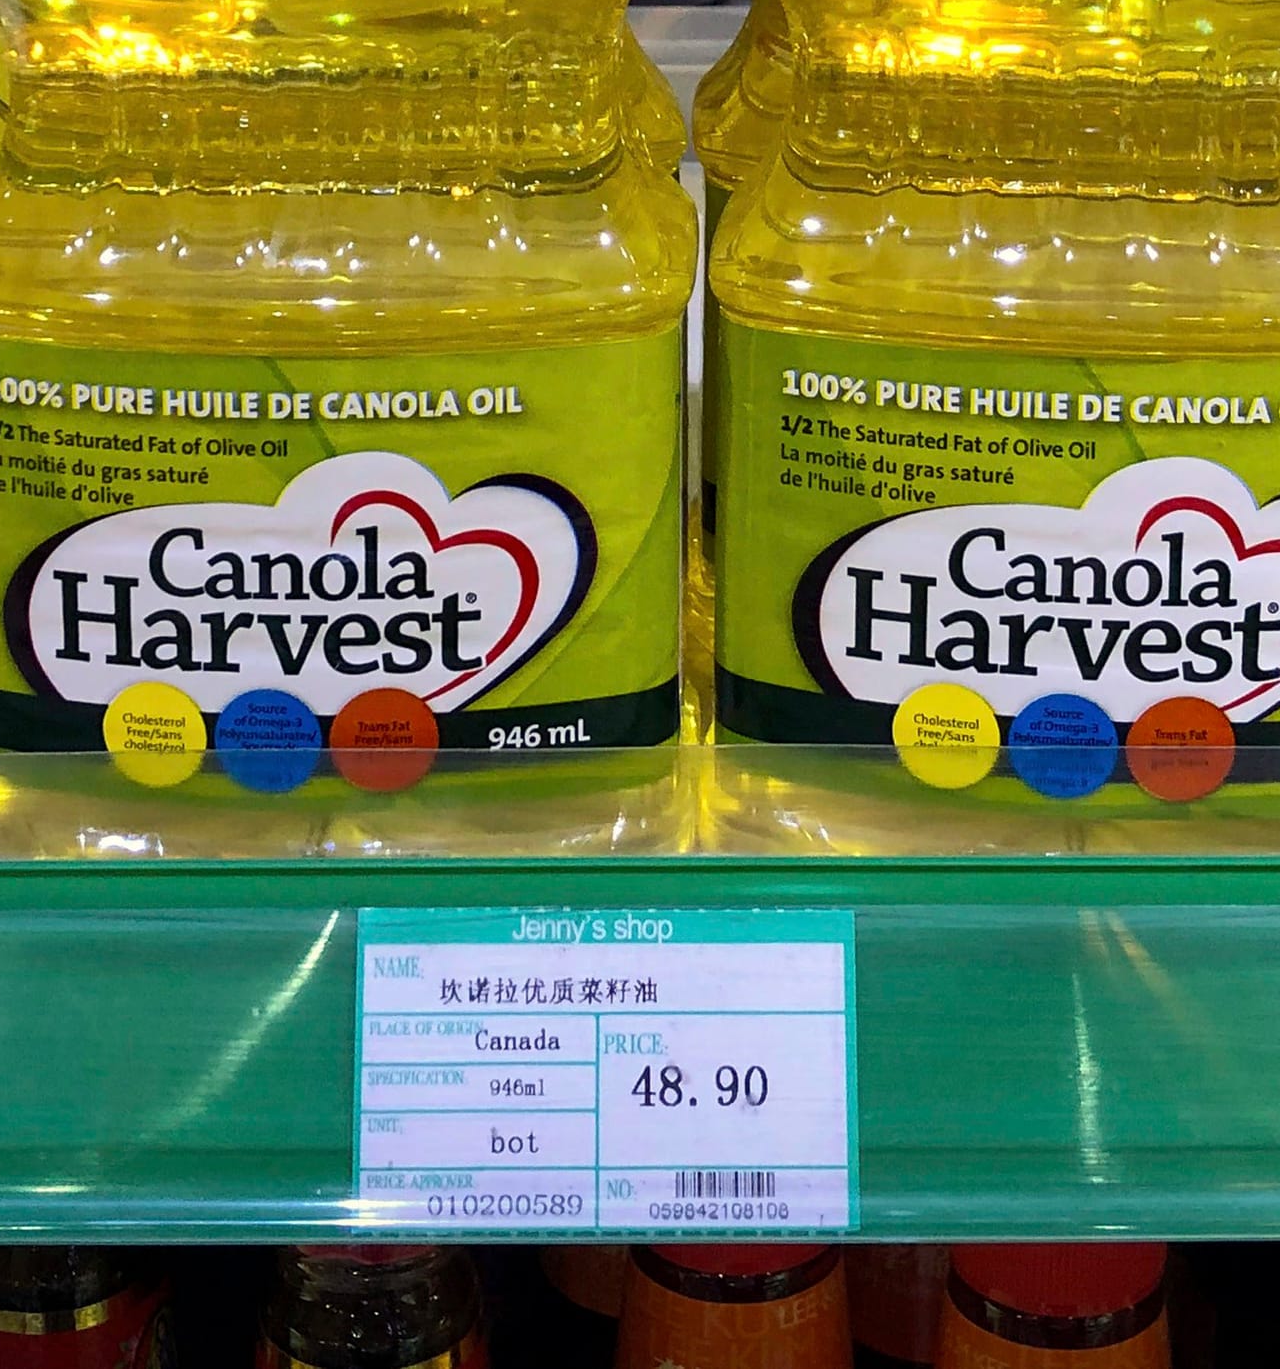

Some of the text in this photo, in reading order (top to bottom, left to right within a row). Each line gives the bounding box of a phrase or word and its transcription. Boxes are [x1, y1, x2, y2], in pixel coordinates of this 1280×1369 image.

[72, 384, 154, 414] PURE
[162, 389, 259, 419] HUILE
[268, 392, 311, 419] DE
[318, 392, 457, 419] CANOLA
[467, 387, 521, 415] OIL
[782, 370, 867, 406] 100%
[876, 381, 960, 414] PURE
[970, 389, 1069, 421] HUILE
[1078, 394, 1121, 422] DE
[1129, 395, 1270, 425] CANOLA
[18, 425, 49, 447] The
[54, 428, 143, 454] Saturated
[149, 433, 177, 454] Fat
[182, 435, 201, 456] of
[206, 435, 255, 456] Olive
[261, 438, 288, 457] Oil
[781, 415, 1096, 460] 1/2 The Saturated Fat of Olive Oil
[8, 451, 66, 474] moitié
[72, 456, 96, 476] du
[101, 464, 141, 482] gras
[147, 465, 209, 484] saturé
[780, 443, 1014, 486] La moitié du gras saturé
[72, 482, 135, 506] d'olive
[780, 468, 802, 488] de
[870, 481, 936, 504] d'olive
[149, 526, 433, 602] Canola
[948, 527, 1236, 608] Canola
[54, 570, 486, 676] Harvest
[122, 713, 186, 728] Cholesterol
[247, 704, 288, 716] Source
[913, 714, 980, 730] Cholesterol
[127, 725, 182, 741] Free/Sans
[488, 719, 590, 750] 946 mL
[917, 729, 976, 743] Free/Sans
[512, 914, 674, 943] Jenny's shop
[439, 977, 659, 1006] 坎诺拉优质菜籽油
[369, 1022, 434, 1037] PLACE OF
[474, 1030, 561, 1052] Canada
[604, 1034, 669, 1056] PRICE:
[490, 1079, 546, 1098] 946ml
[632, 1065, 769, 1108] 48.90
[491, 1131, 540, 1154] bot
[367, 1175, 406, 1189] PRICE
[427, 1194, 584, 1217] 010200589
